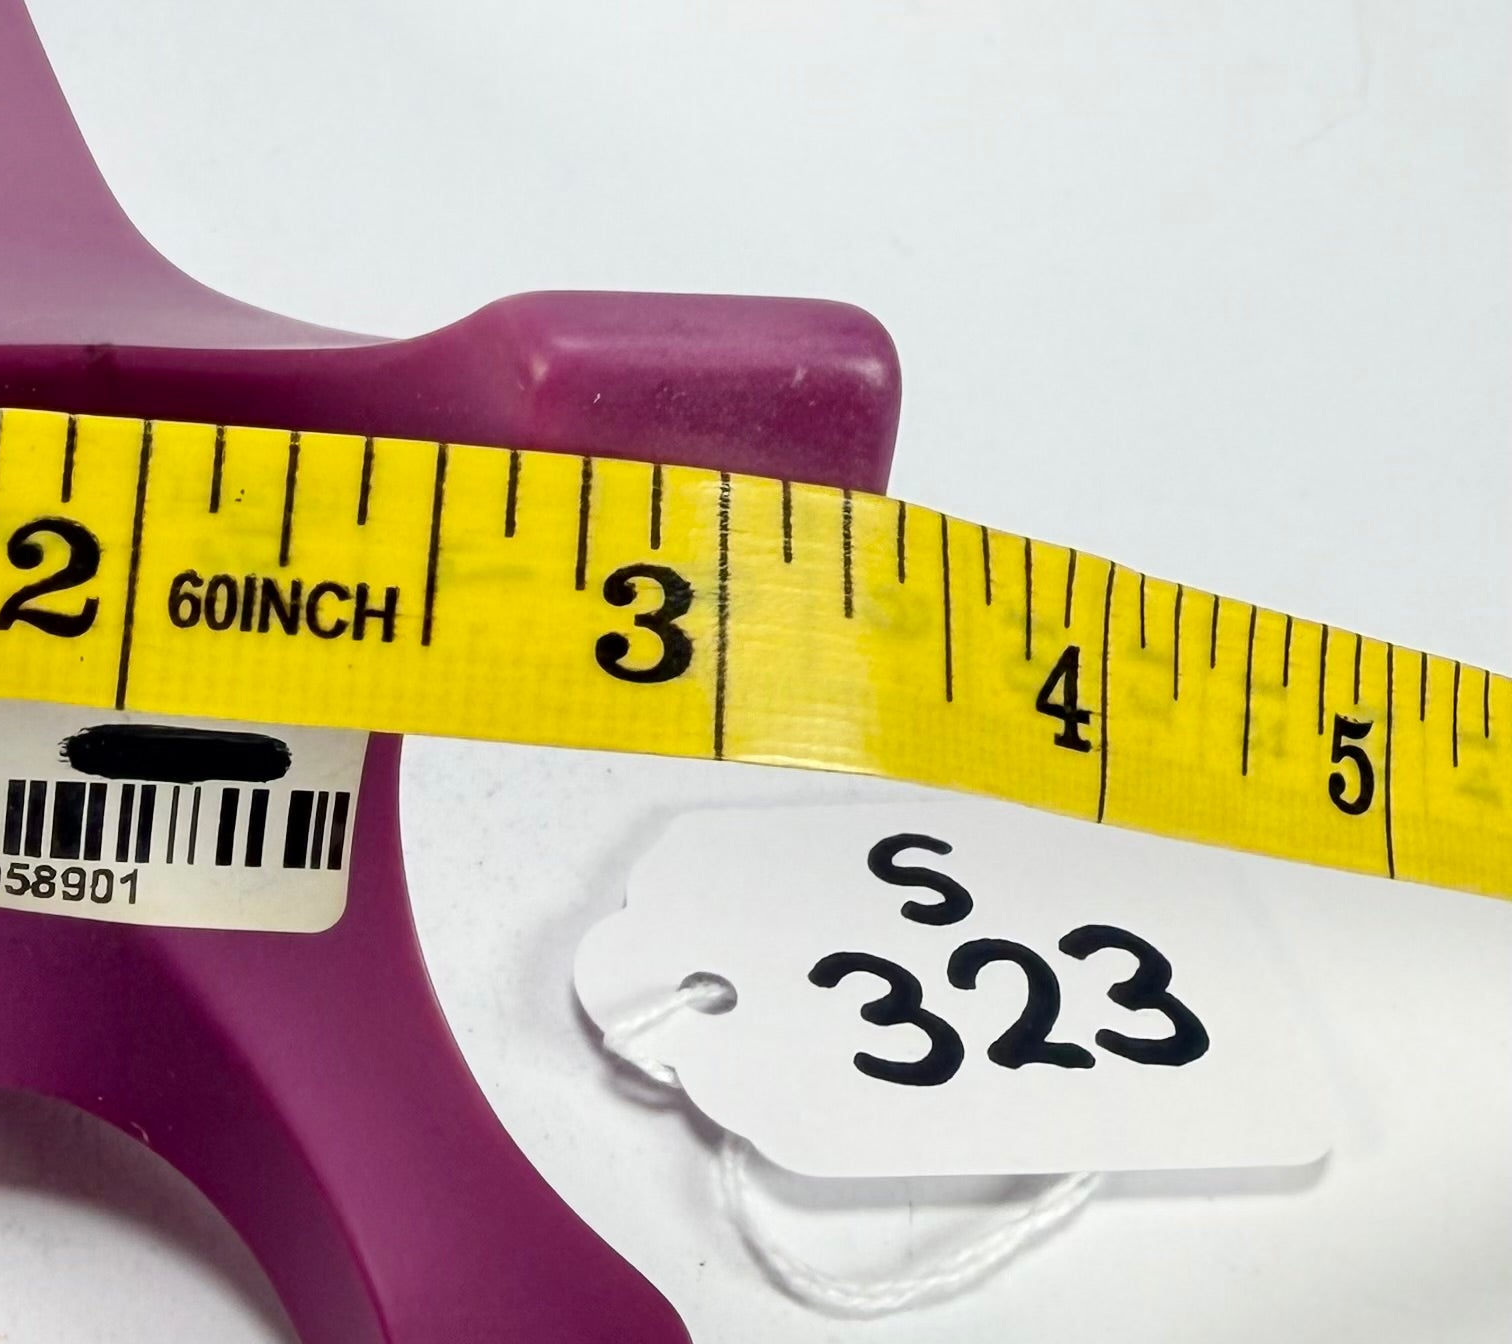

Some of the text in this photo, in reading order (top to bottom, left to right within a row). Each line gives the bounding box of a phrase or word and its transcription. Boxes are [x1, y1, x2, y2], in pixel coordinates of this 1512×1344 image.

[167, 568, 401, 644] 60INCH
[594, 561, 695, 684] 3
[1035, 645, 1092, 753] 4
[1328, 712, 1375, 816] 5
[867, 832, 974, 926] S
[807, 923, 1211, 1087] 323
